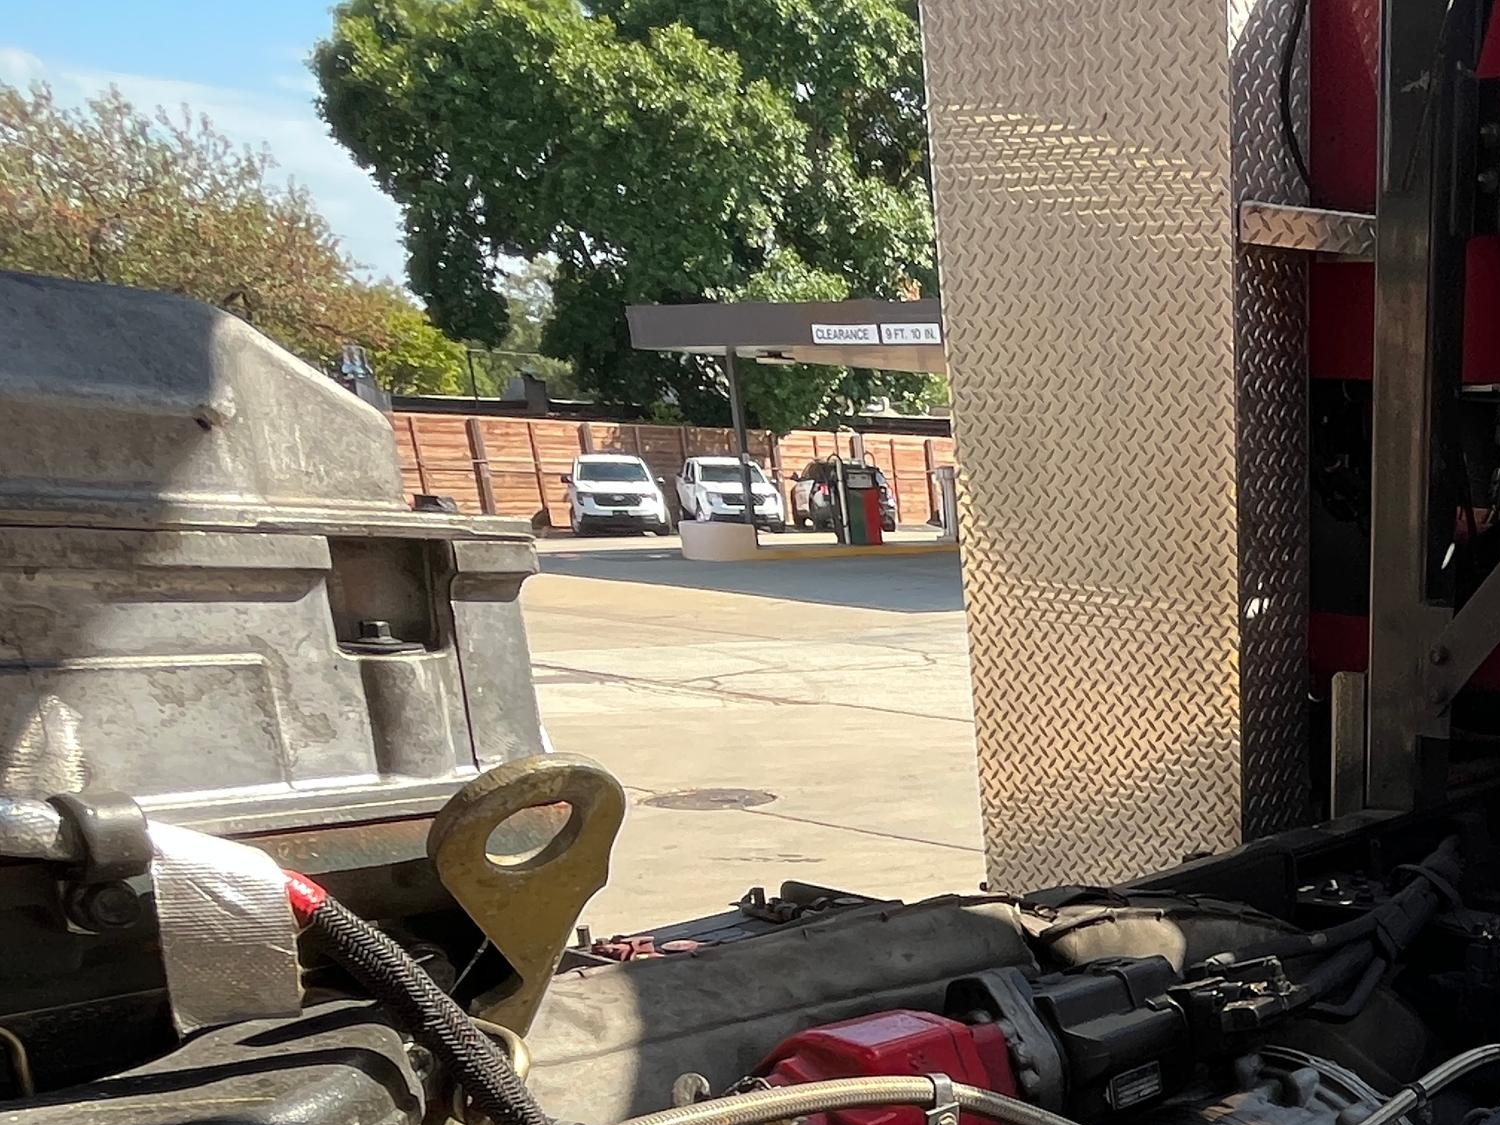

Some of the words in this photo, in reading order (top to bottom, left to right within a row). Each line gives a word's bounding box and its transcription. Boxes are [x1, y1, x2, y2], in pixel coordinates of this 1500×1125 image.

[815, 328, 869, 341] CLEARANCE
[885, 328, 892, 340] 9
[911, 328, 921, 340] 10
